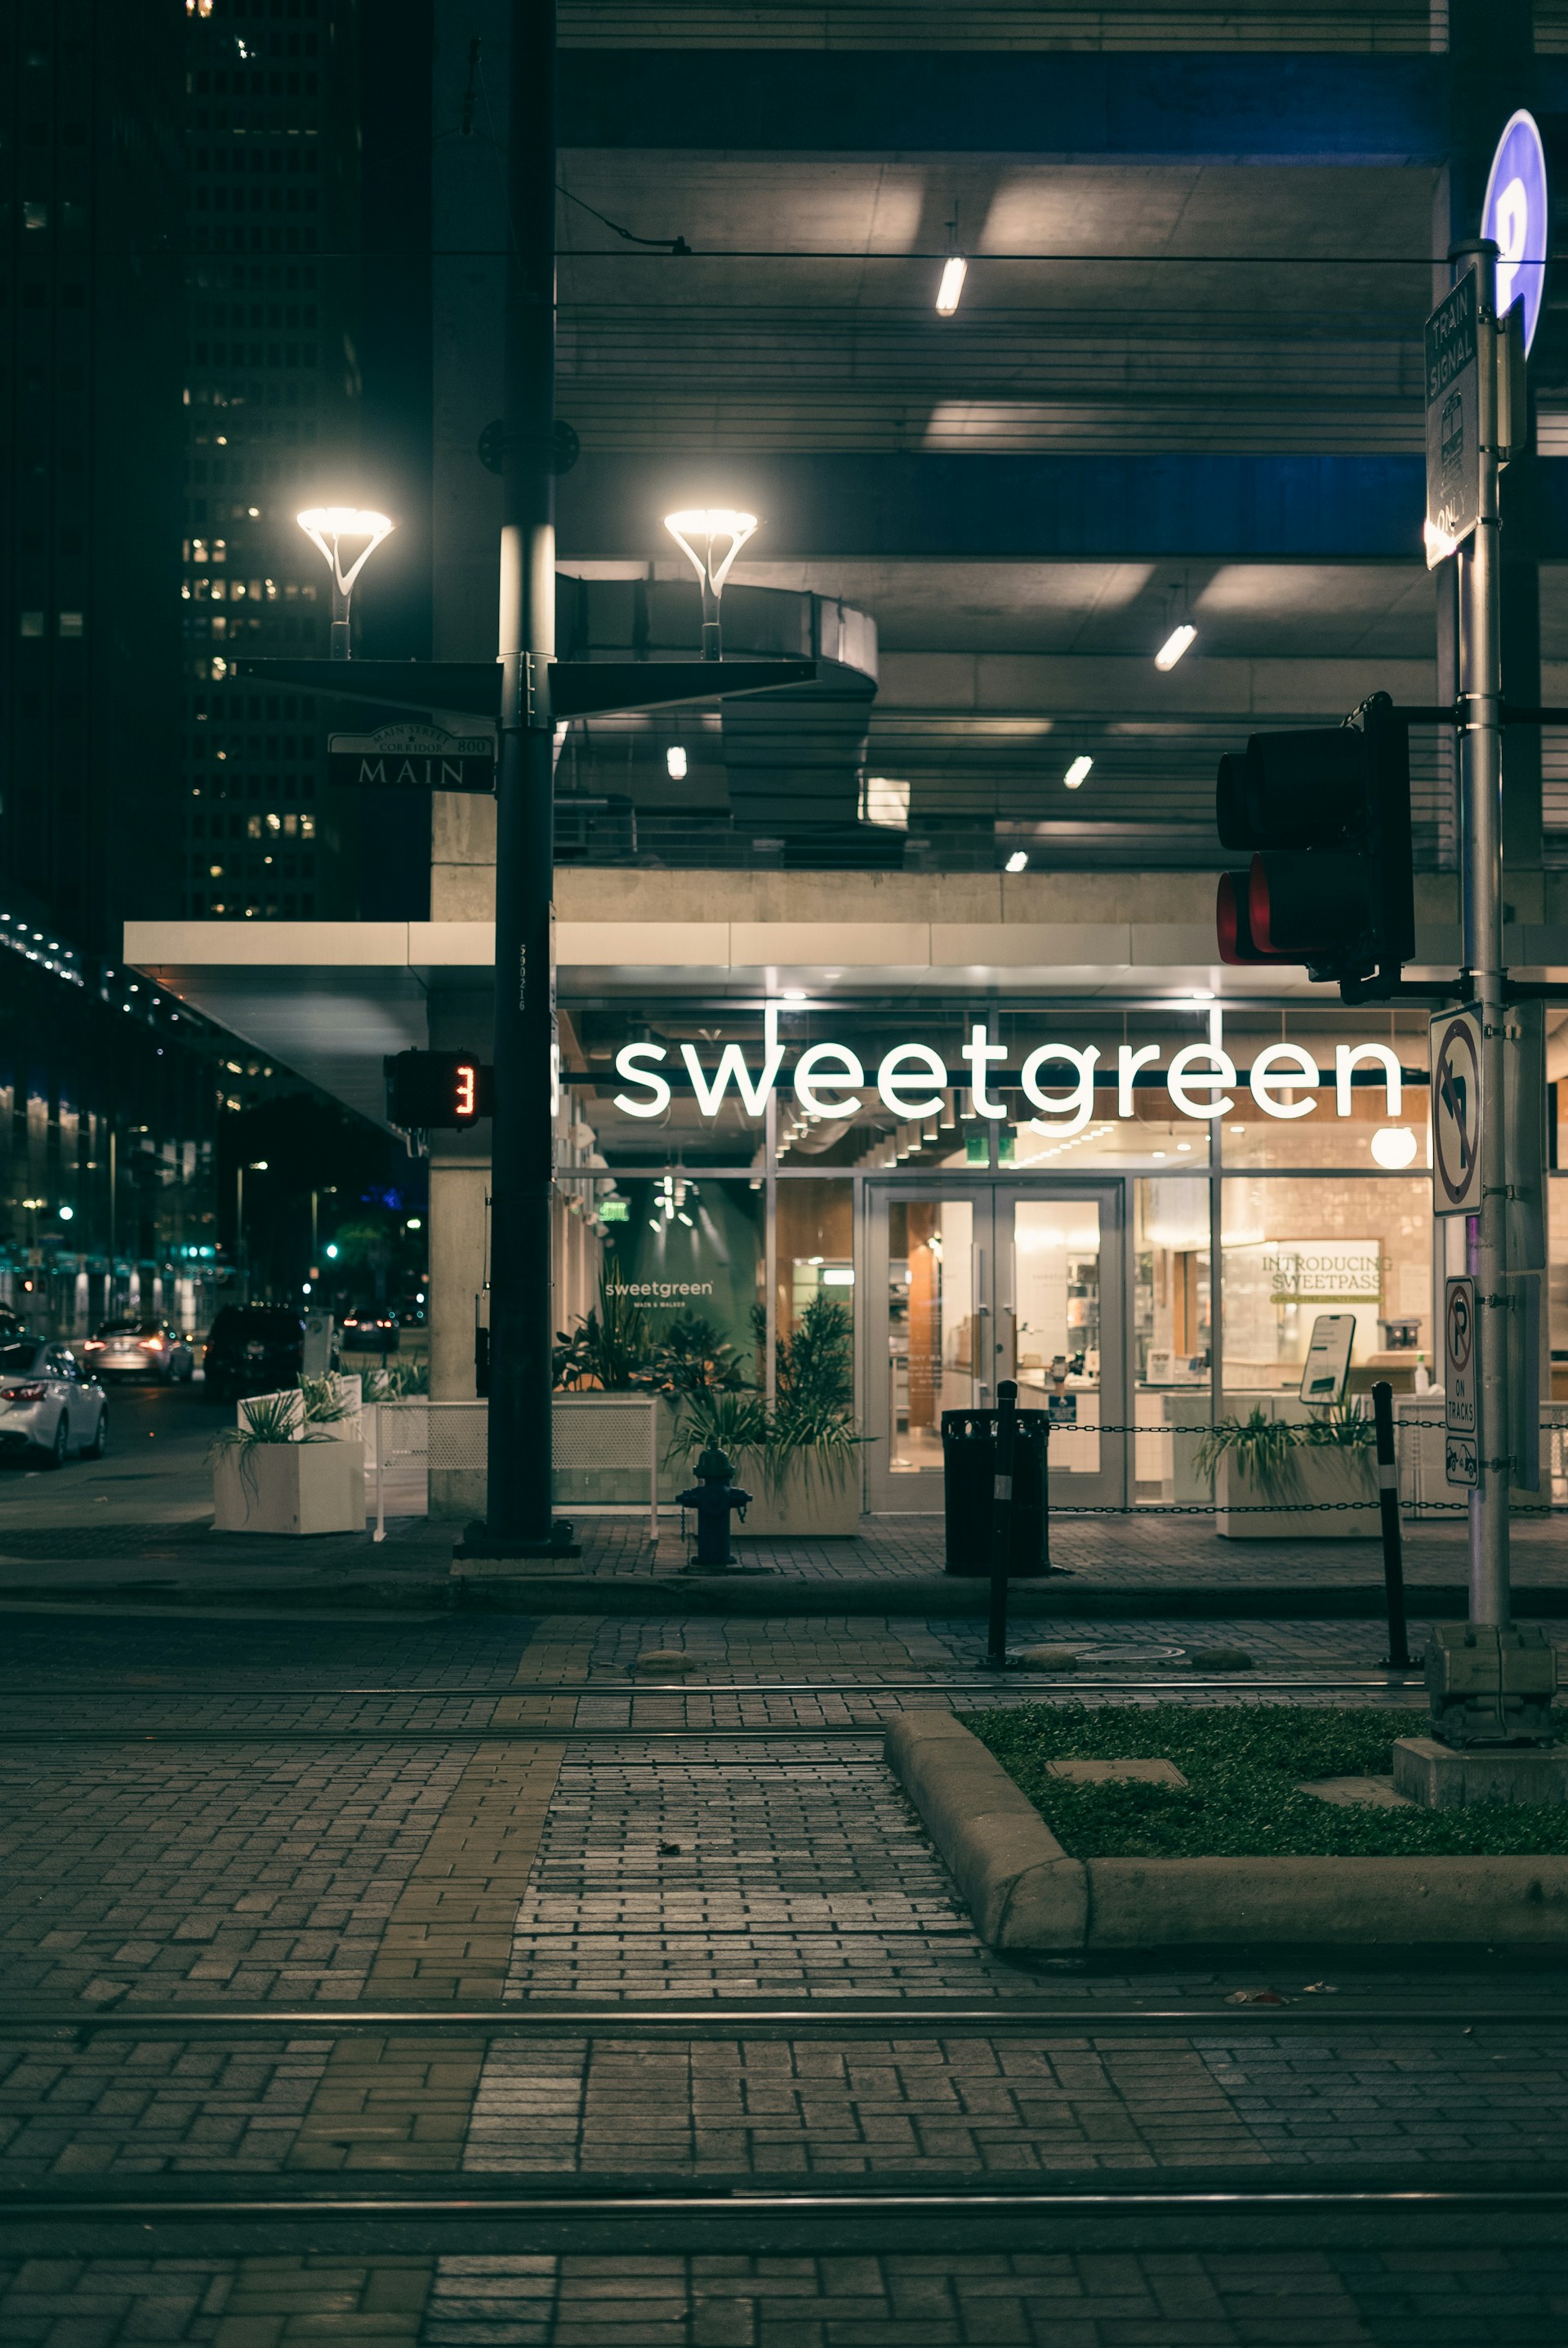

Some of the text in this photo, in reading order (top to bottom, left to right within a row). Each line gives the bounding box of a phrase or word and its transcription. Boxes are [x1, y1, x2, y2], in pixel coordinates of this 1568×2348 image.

[1494, 177, 1527, 319] P
[1433, 287, 1468, 349] TRAIN
[1431, 330, 1472, 396] SIGNAL
[373, 725, 450, 745] MAIN STREET
[380, 743, 443, 753] CORRIDOR
[457, 741, 486, 753] 800
[358, 758, 466, 784] MAIN
[456, 1066, 474, 1114] 3
[613, 1024, 1401, 1138] sweetgreen
[1263, 1257, 1393, 1272] INTRODUCING
[605, 1281, 713, 1298] sweetgreen
[1272, 1275, 1383, 1290] SWEETPASS
[1456, 1379, 1465, 1397] ON
[1449, 1401, 1473, 1422] TRACKS
